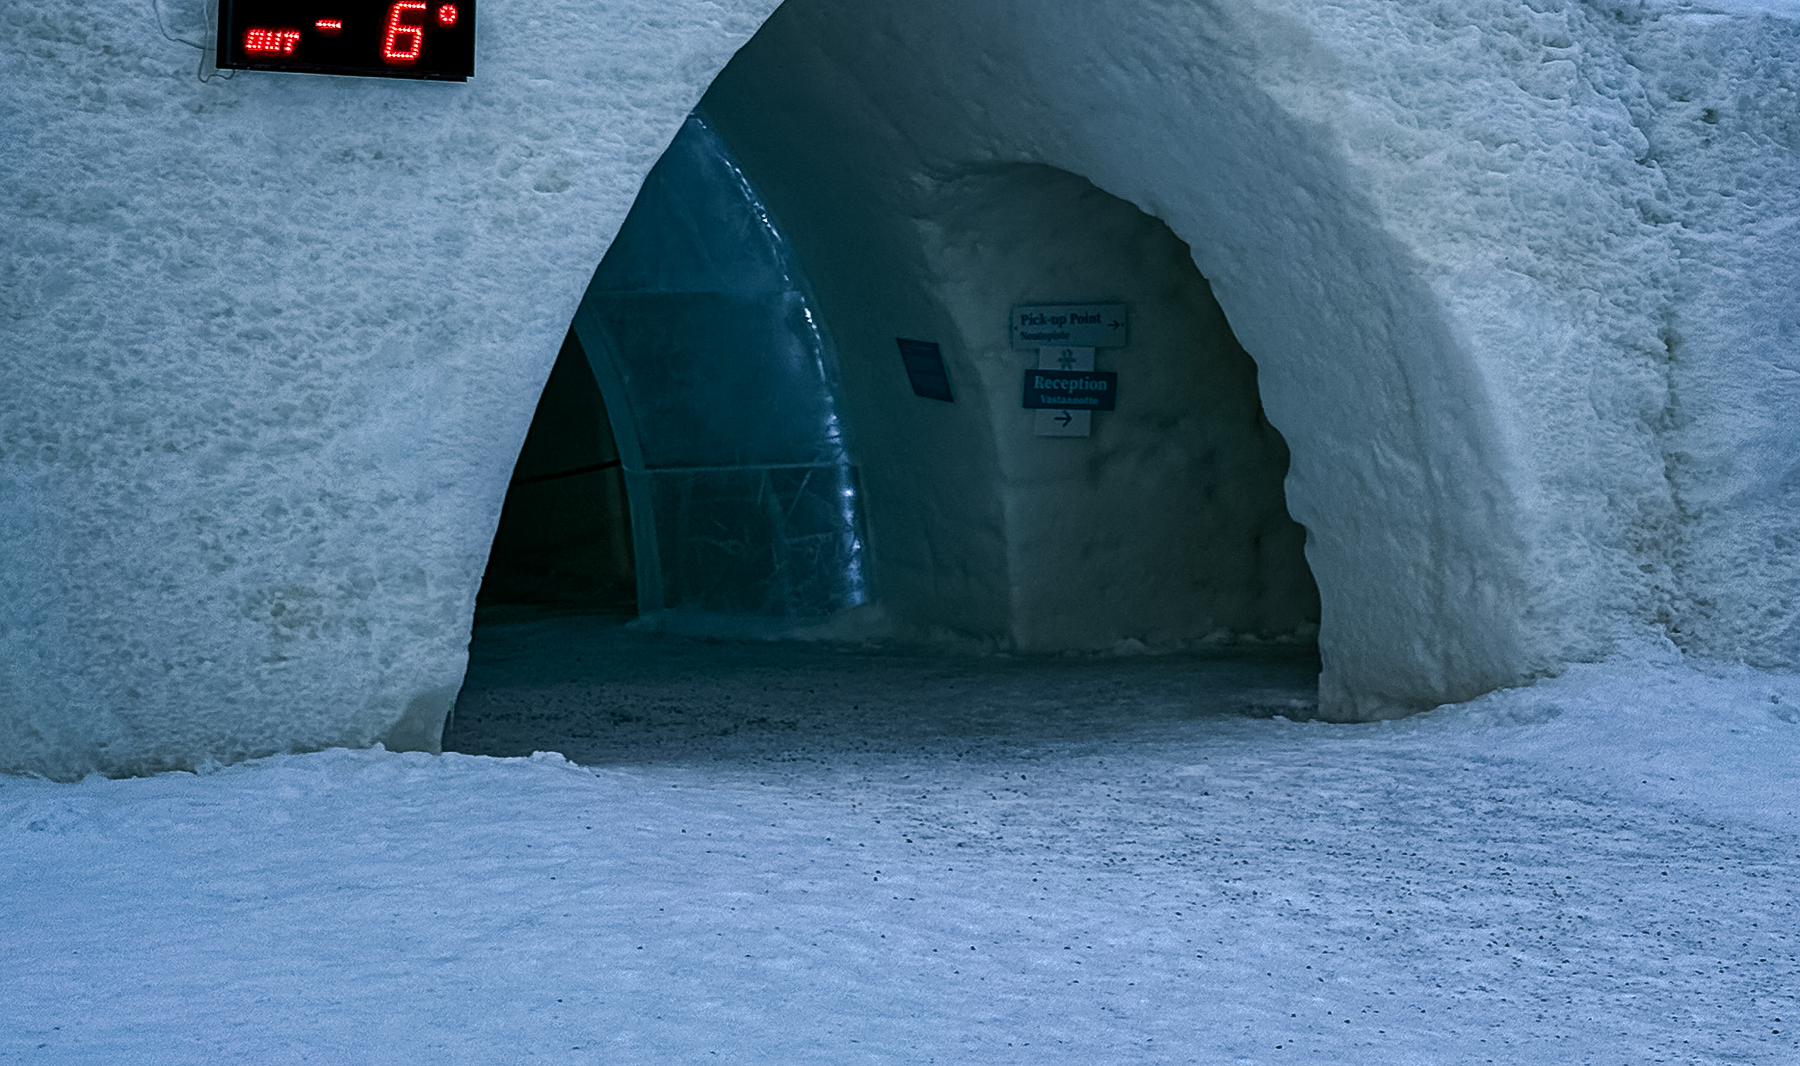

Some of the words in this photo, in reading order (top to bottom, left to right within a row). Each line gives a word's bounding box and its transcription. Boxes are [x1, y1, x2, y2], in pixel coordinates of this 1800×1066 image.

[1020, 312, 1067, 328] Pick-up
[1070, 311, 1102, 325] Point
[1033, 375, 1108, 394] Reception
